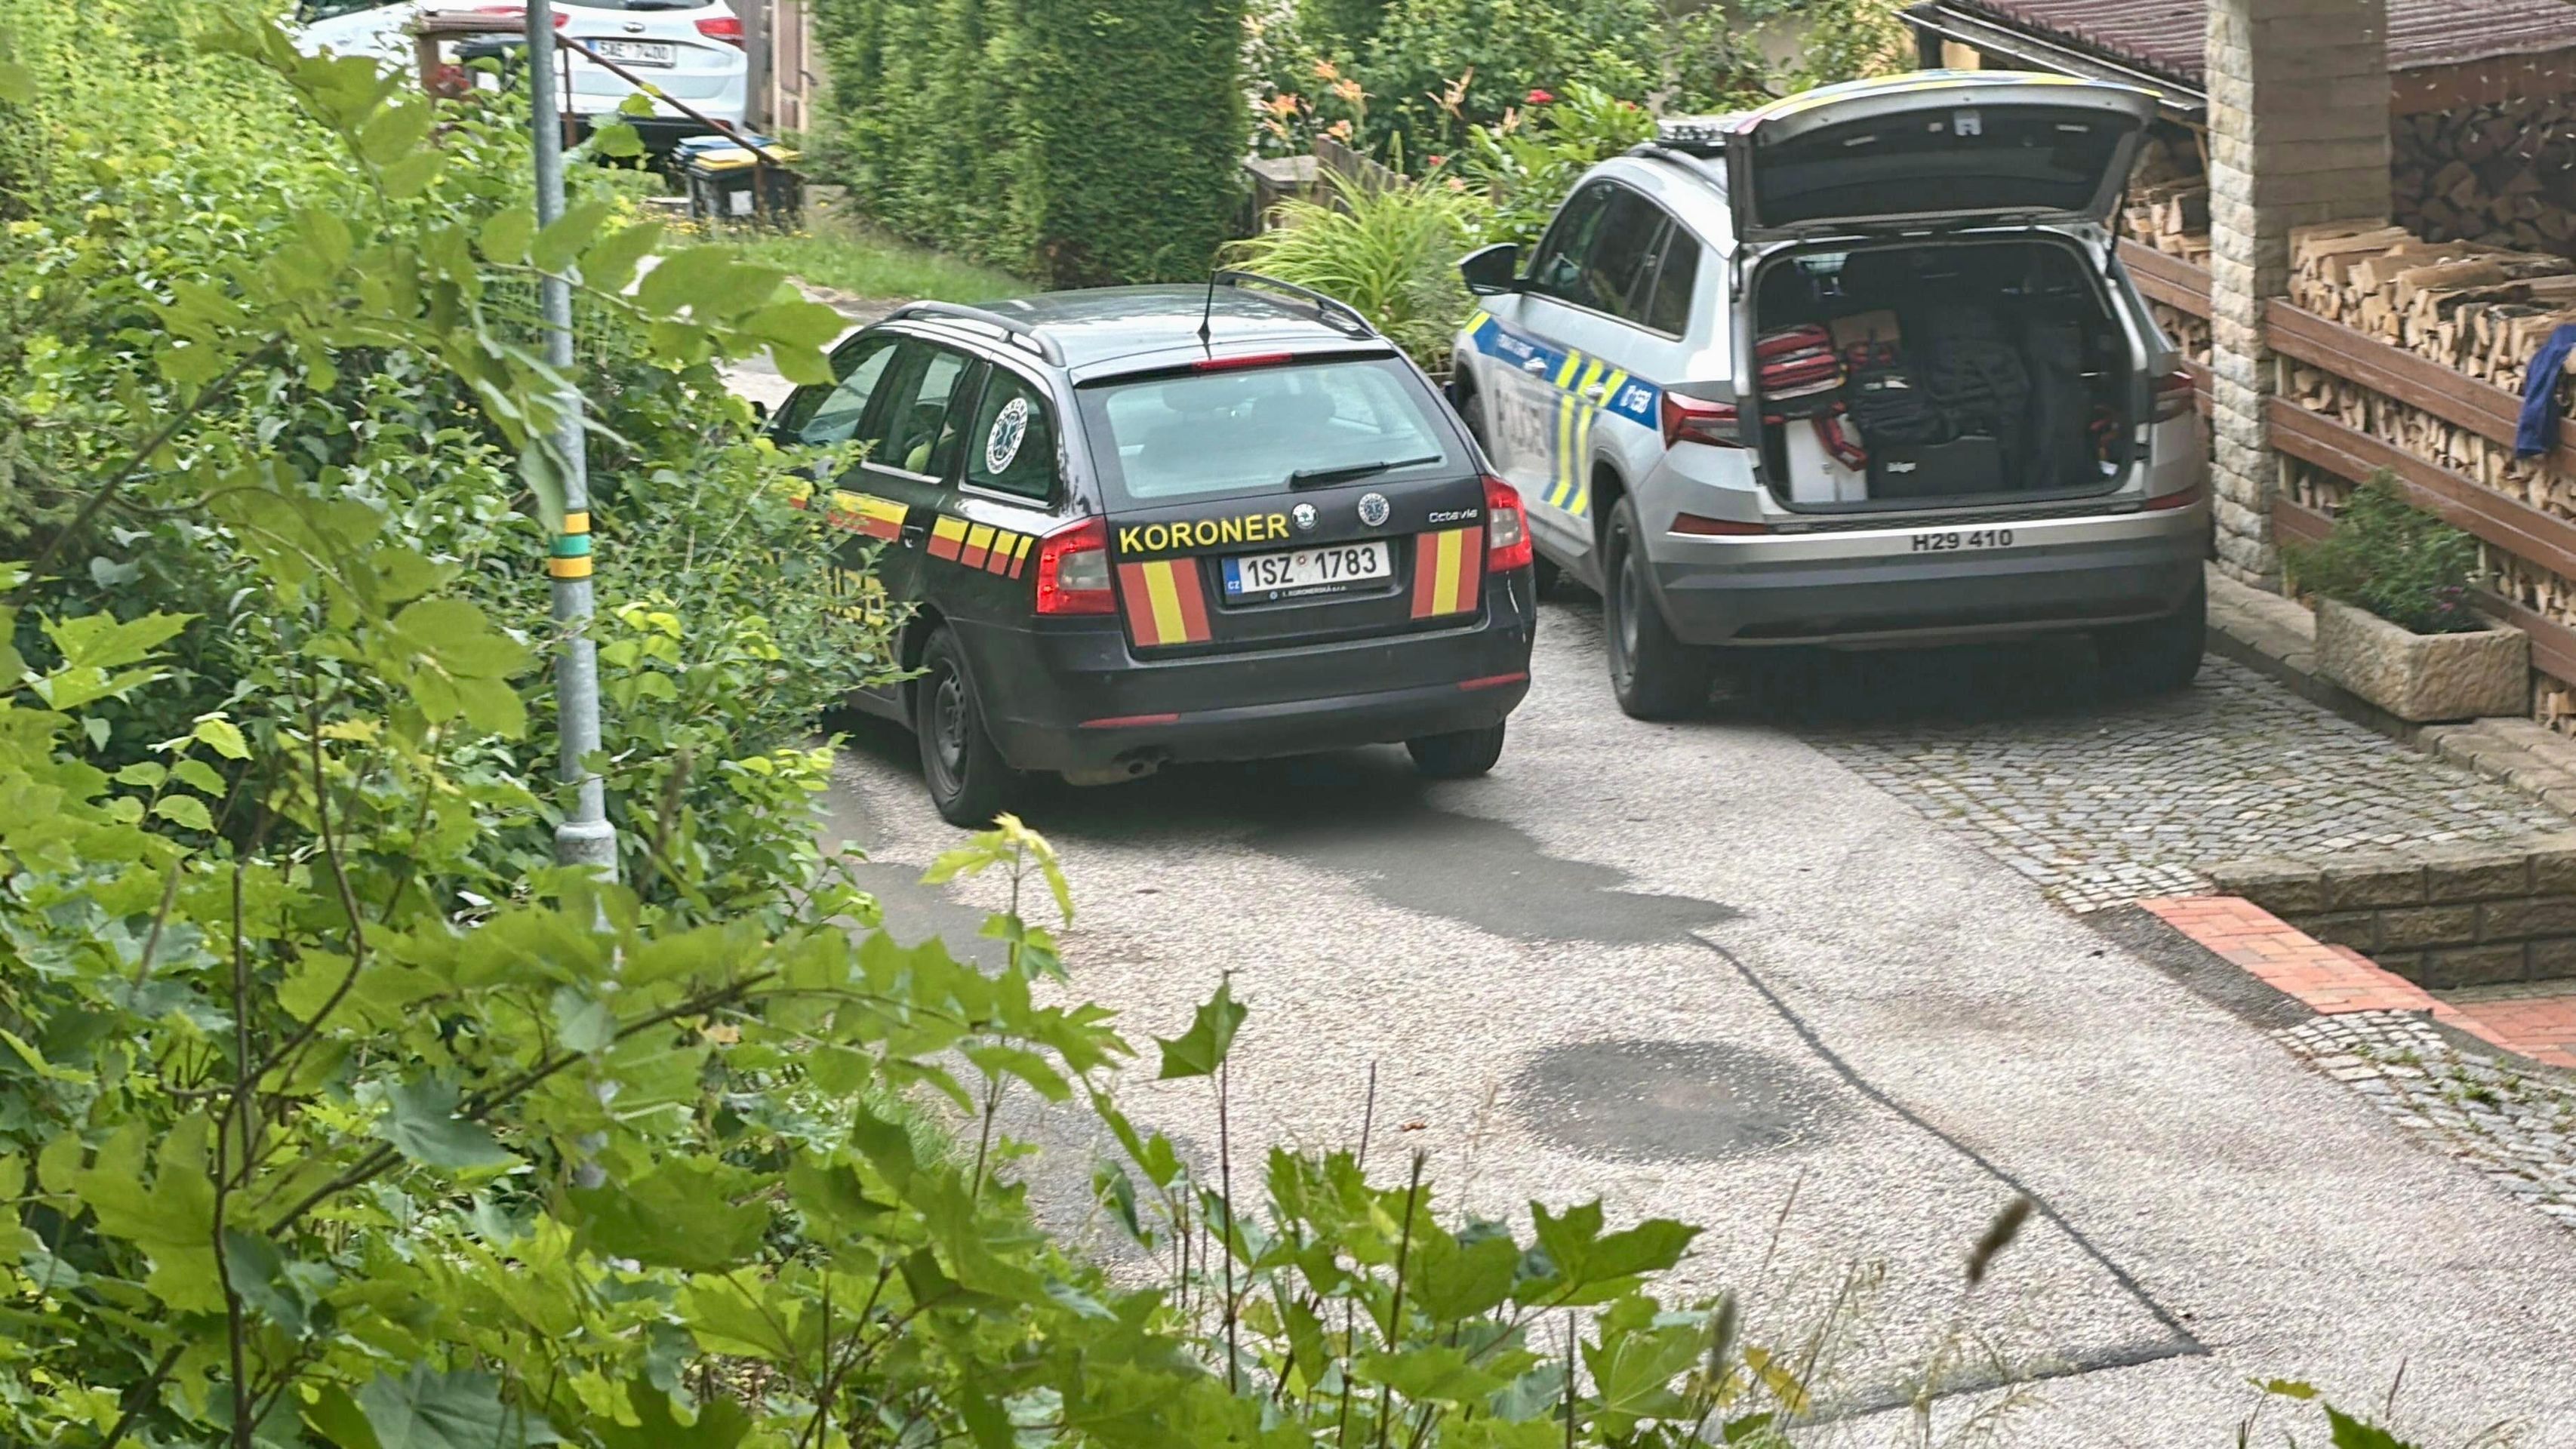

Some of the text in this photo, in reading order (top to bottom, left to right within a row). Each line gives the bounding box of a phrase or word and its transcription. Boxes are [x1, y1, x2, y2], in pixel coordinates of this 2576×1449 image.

[1429, 509, 1478, 523] Octavia
[1119, 512, 1289, 554] KORONER
[1912, 528, 2014, 552] H29 410
[1247, 547, 1377, 587] 1SZ 1783
[1227, 580, 1240, 590] CZ
